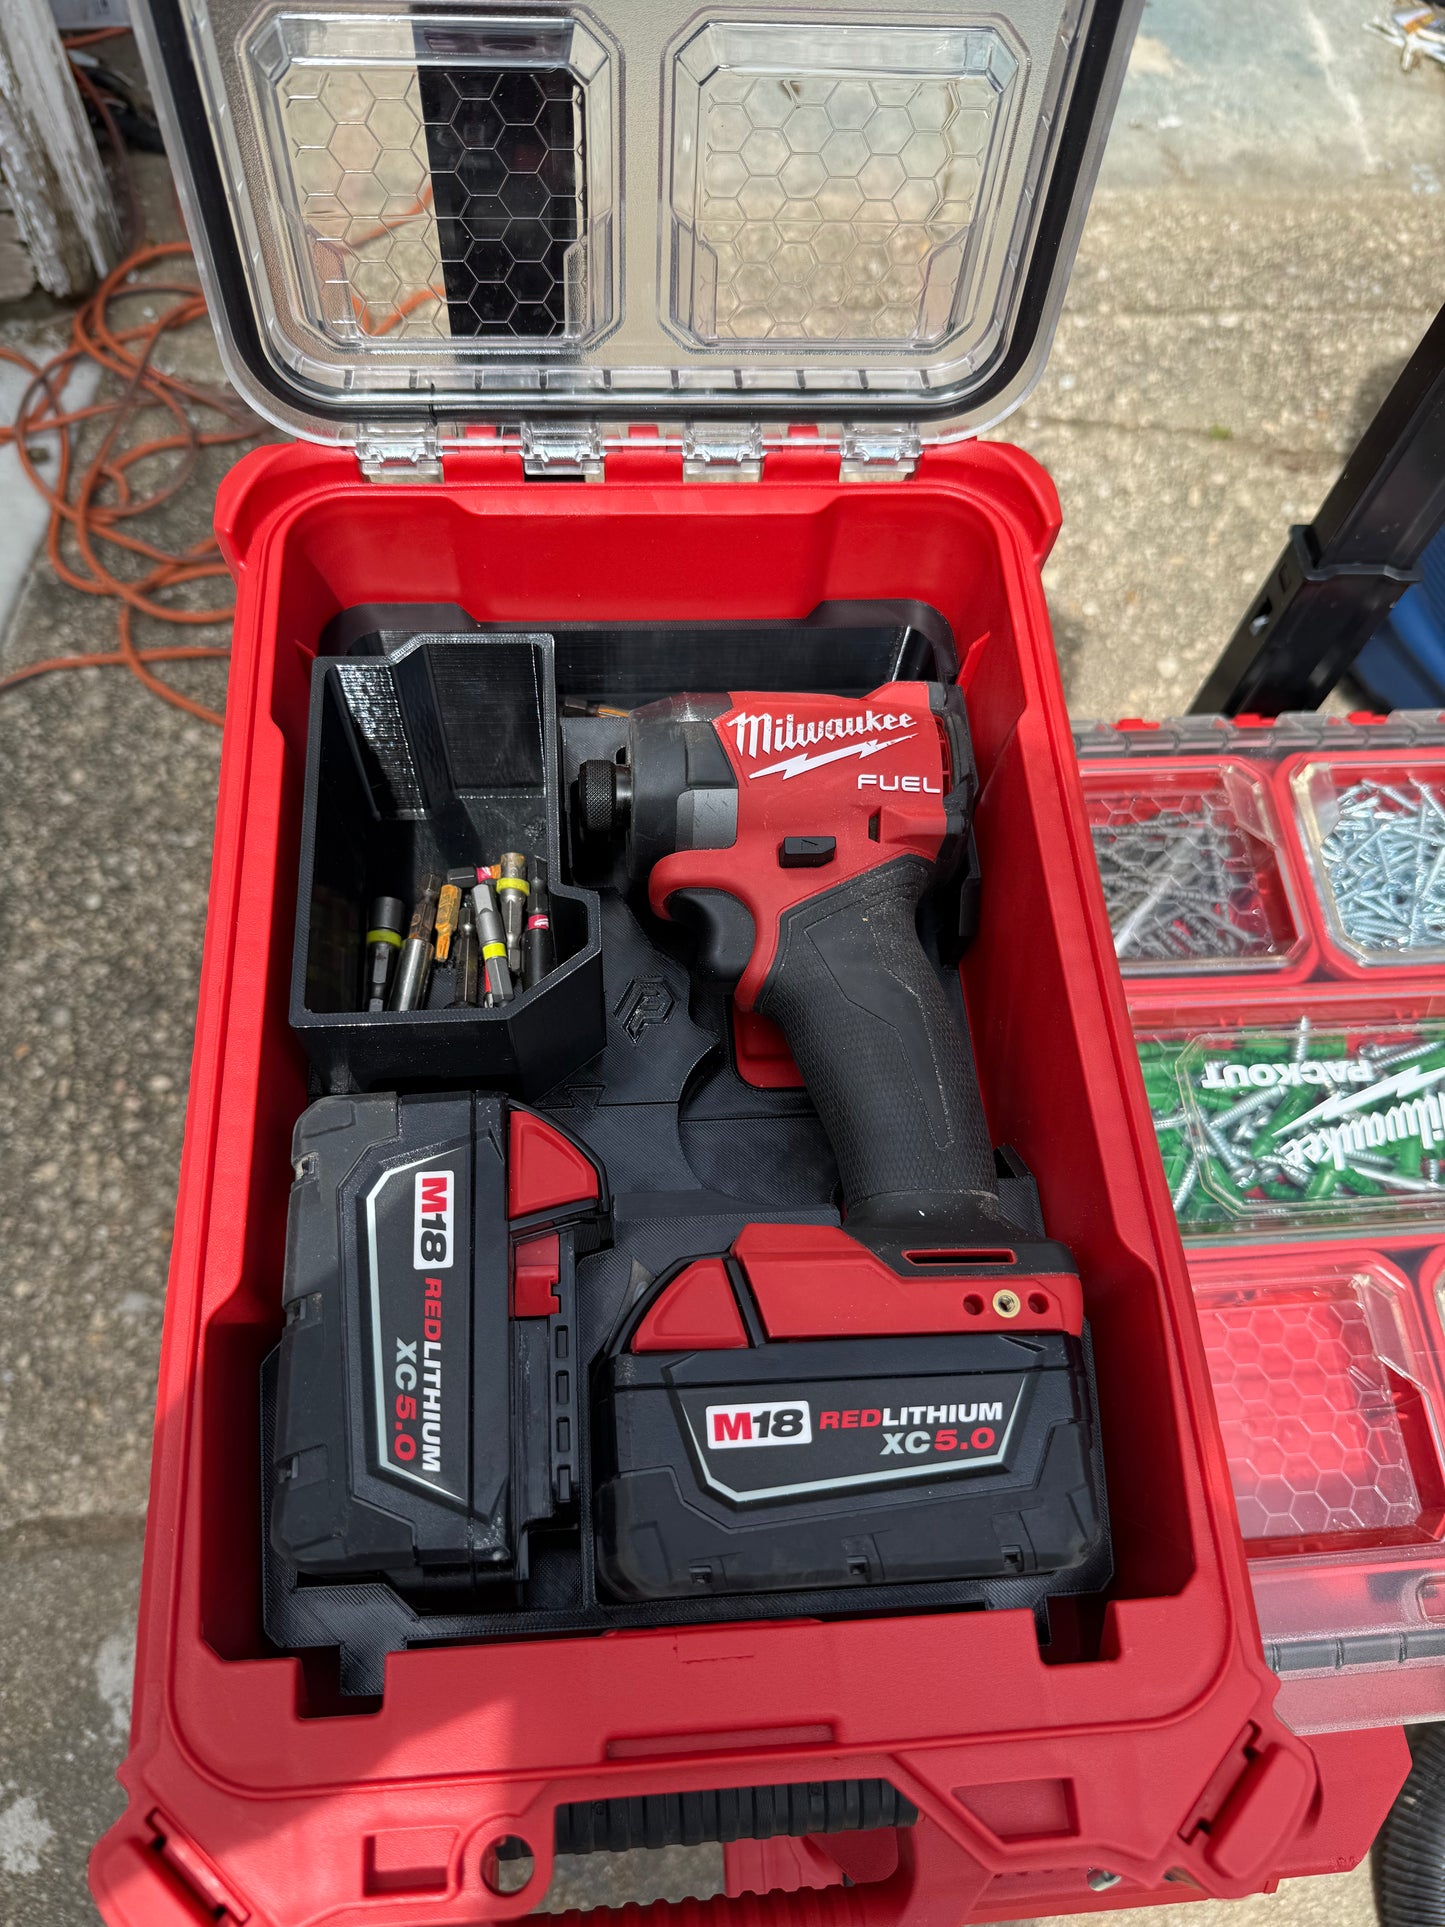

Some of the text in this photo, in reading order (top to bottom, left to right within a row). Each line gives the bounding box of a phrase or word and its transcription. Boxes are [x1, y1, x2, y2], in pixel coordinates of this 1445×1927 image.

[726, 710, 917, 758] Milwaukee
[857, 774, 941, 794] FUEL
[1201, 1059, 1375, 1089] PACKOUT
[1279, 1091, 1445, 1172] ilwaukee
[421, 1176, 448, 1473] M18 REDLITHIUM
[394, 1336, 418, 1462] XC5.0
[713, 1401, 1003, 1442] M18 REDLITHIUM
[879, 1426, 996, 1456] XC5.0
